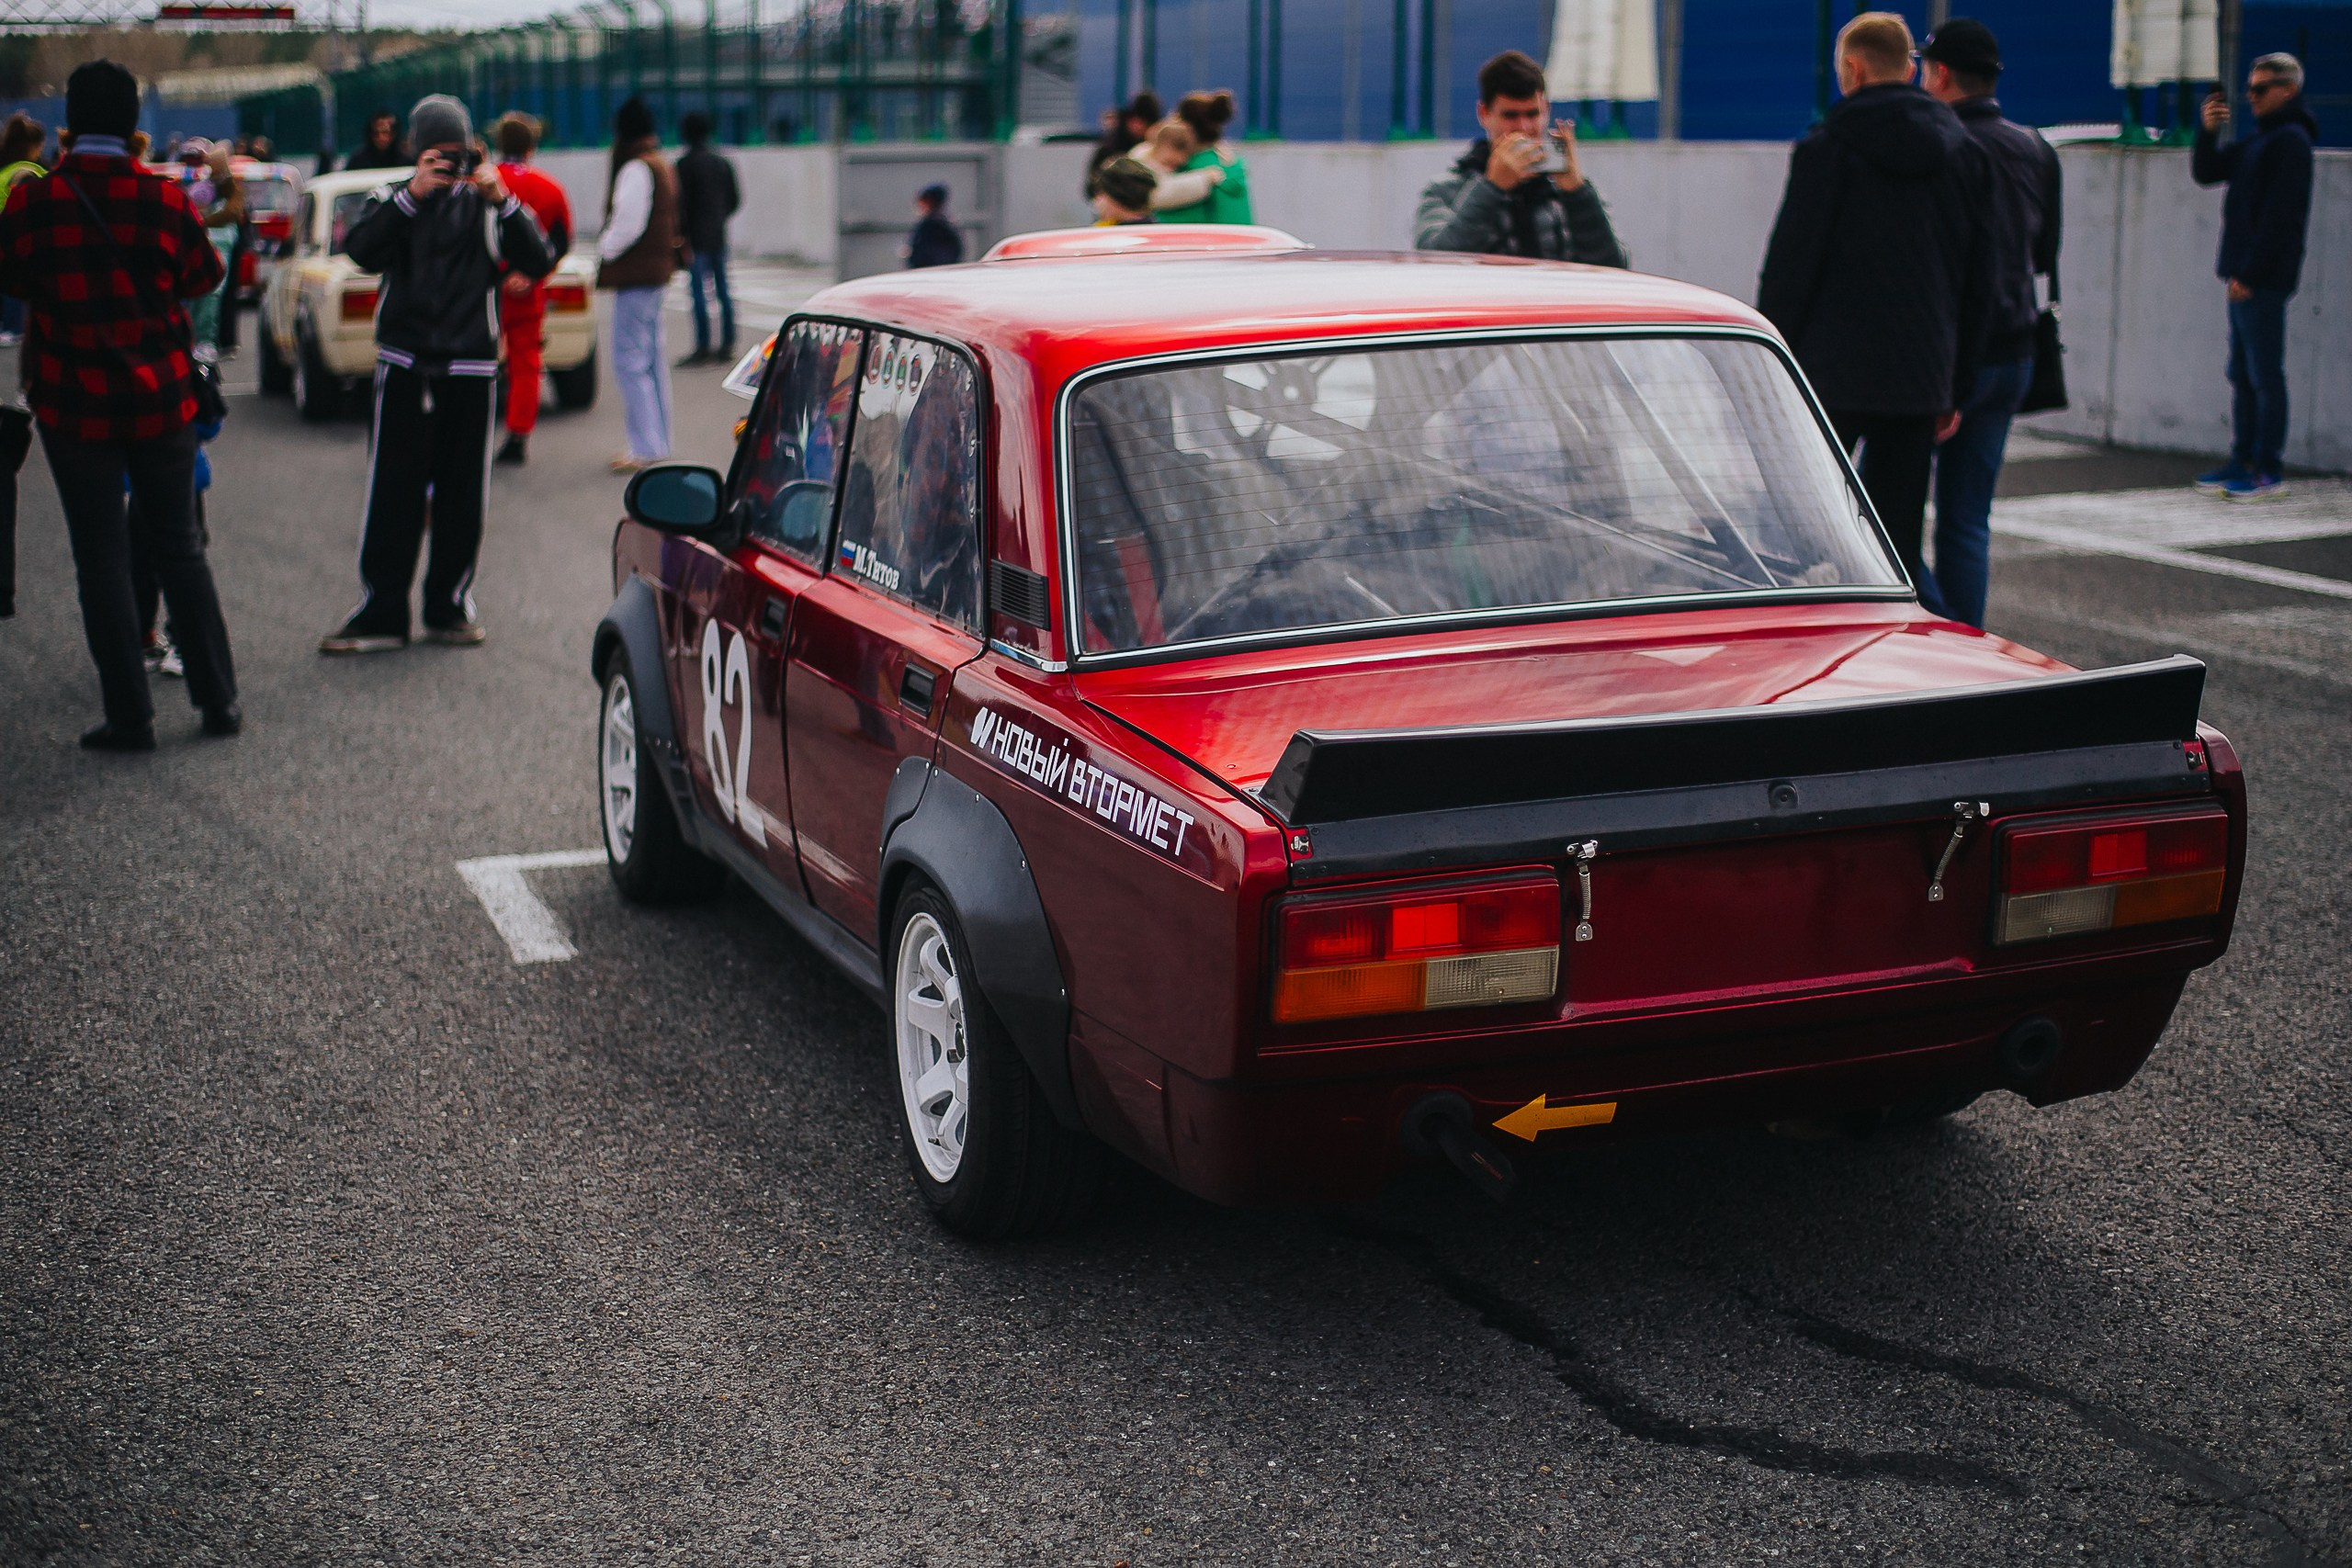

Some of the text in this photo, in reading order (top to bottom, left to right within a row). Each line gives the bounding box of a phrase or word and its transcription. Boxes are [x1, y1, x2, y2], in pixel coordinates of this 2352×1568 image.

[701, 617, 768, 849] 82
[990, 716, 1194, 856] НОВЫЙ ВТОРМЕТ
